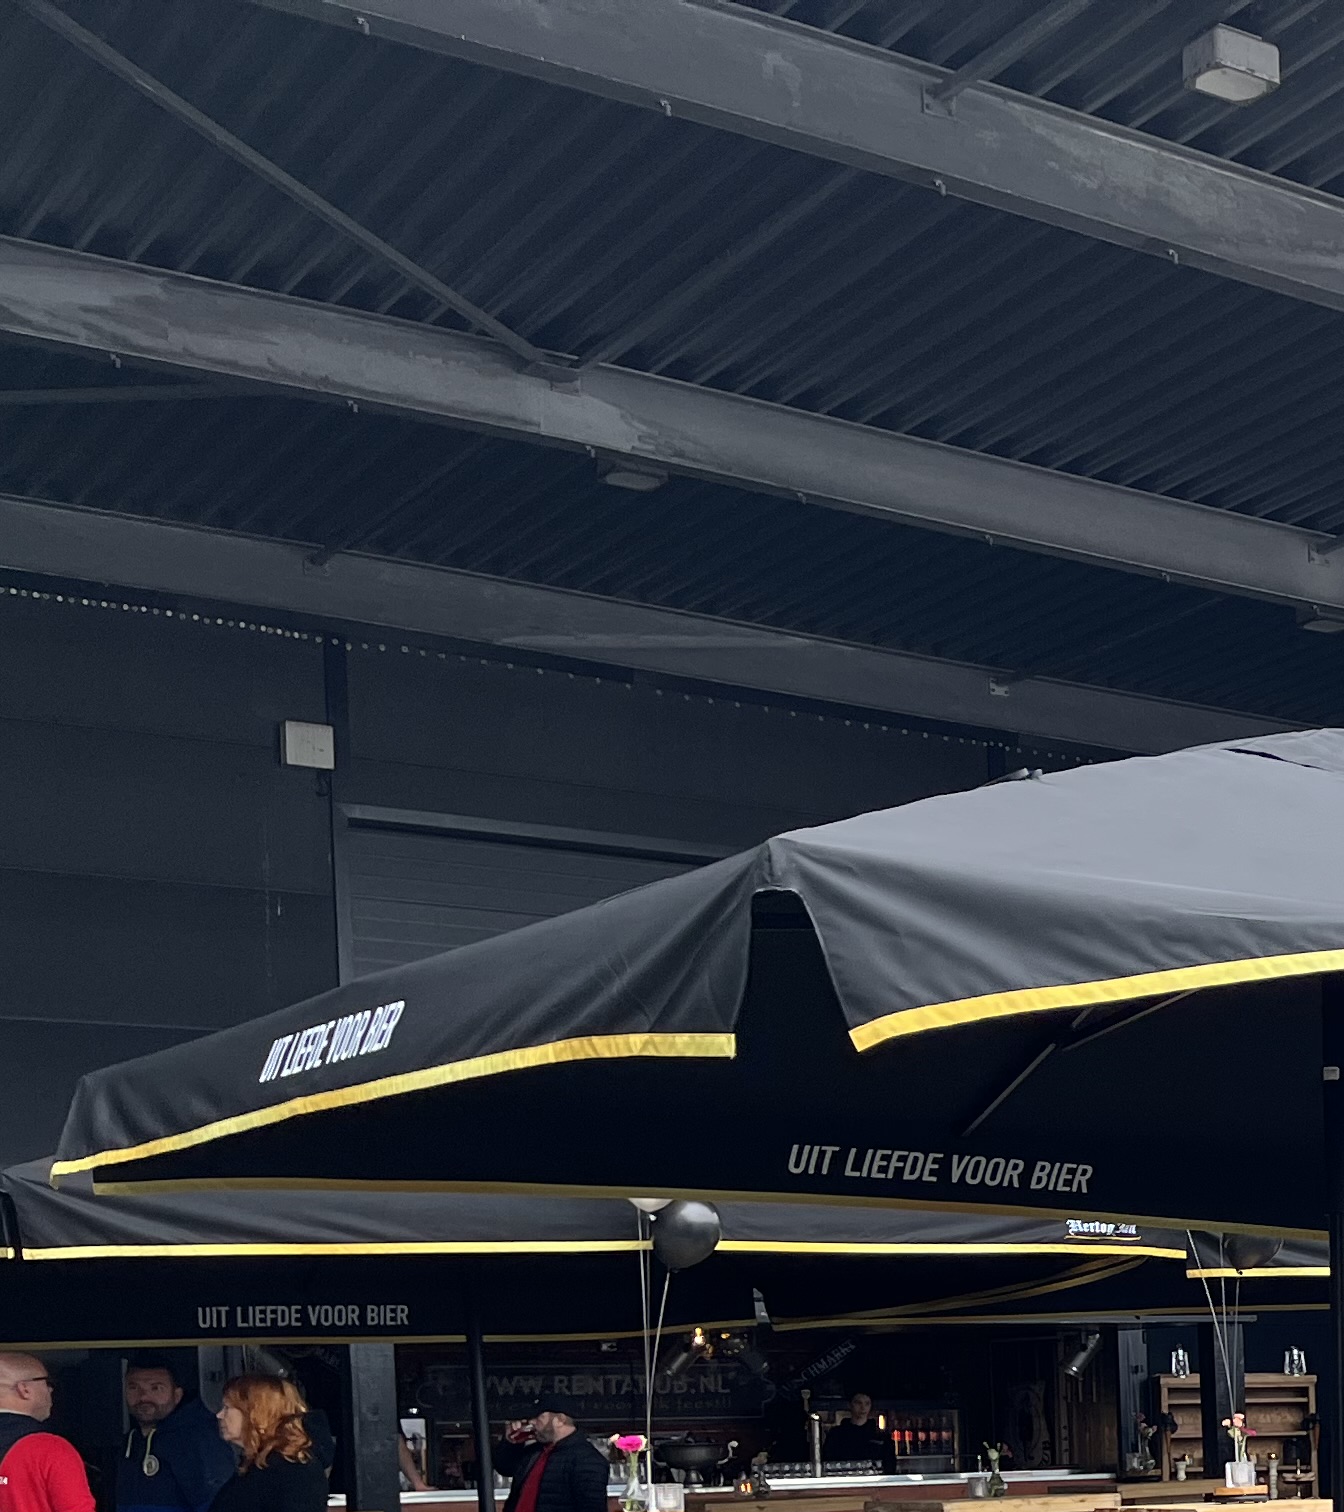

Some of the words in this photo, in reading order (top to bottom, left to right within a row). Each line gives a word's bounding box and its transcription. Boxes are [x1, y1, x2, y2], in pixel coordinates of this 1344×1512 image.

[259, 1034, 294, 1083] UIT
[280, 1020, 336, 1077] LIEFDE
[325, 1010, 372, 1064] VOOR
[359, 1000, 406, 1056] BIER
[787, 1144, 840, 1175] UIT
[844, 1147, 944, 1182] LIEFDE
[951, 1154, 1025, 1188] VOOR
[1029, 1160, 1093, 1193] BIER
[198, 1306, 230, 1328] UIT
[236, 1305, 302, 1328] LIEFDE
[307, 1305, 361, 1327] VOOR
[367, 1304, 409, 1326] BIER
